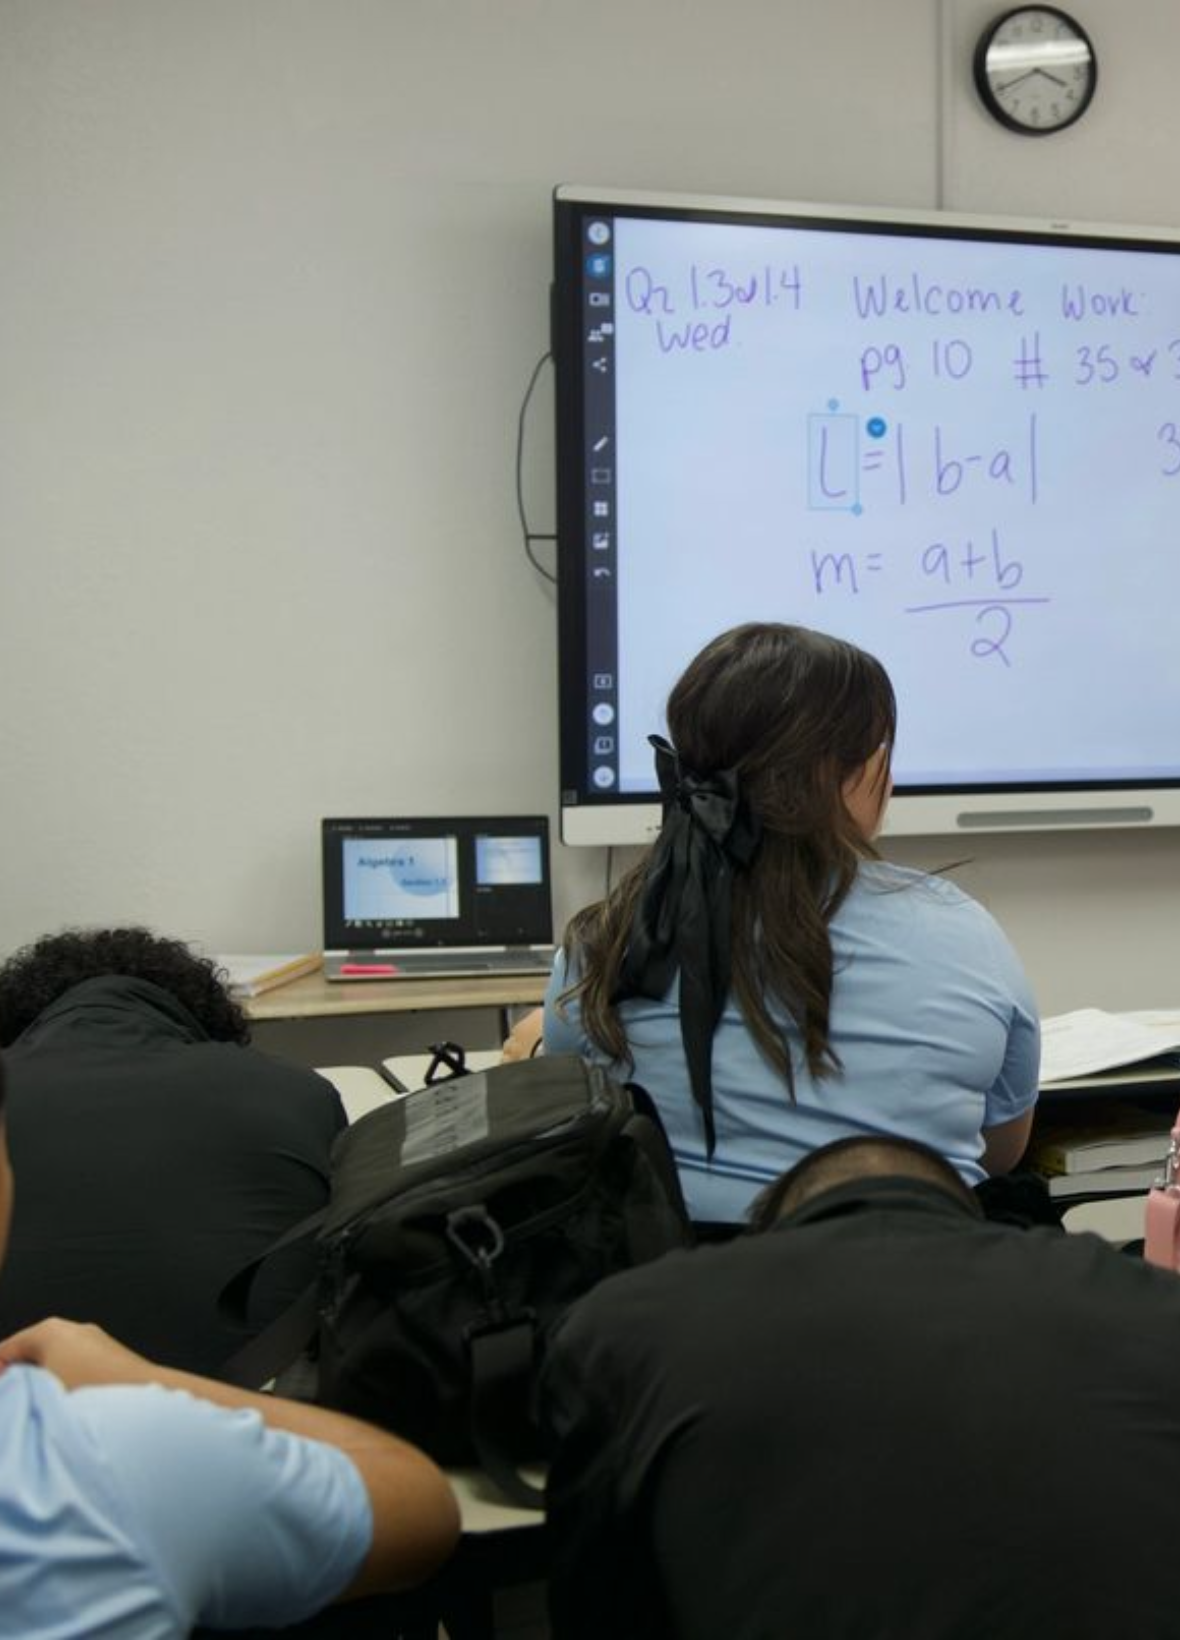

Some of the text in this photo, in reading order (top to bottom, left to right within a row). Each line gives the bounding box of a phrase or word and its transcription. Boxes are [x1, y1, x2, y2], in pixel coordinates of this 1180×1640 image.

[853, 273, 1024, 319] Welcome
[860, 344, 906, 391] pg
[933, 340, 972, 379] 10
[1014, 332, 1049, 390] #
[1076, 345, 1118, 385] 35
[970, 604, 1011, 667] 2
